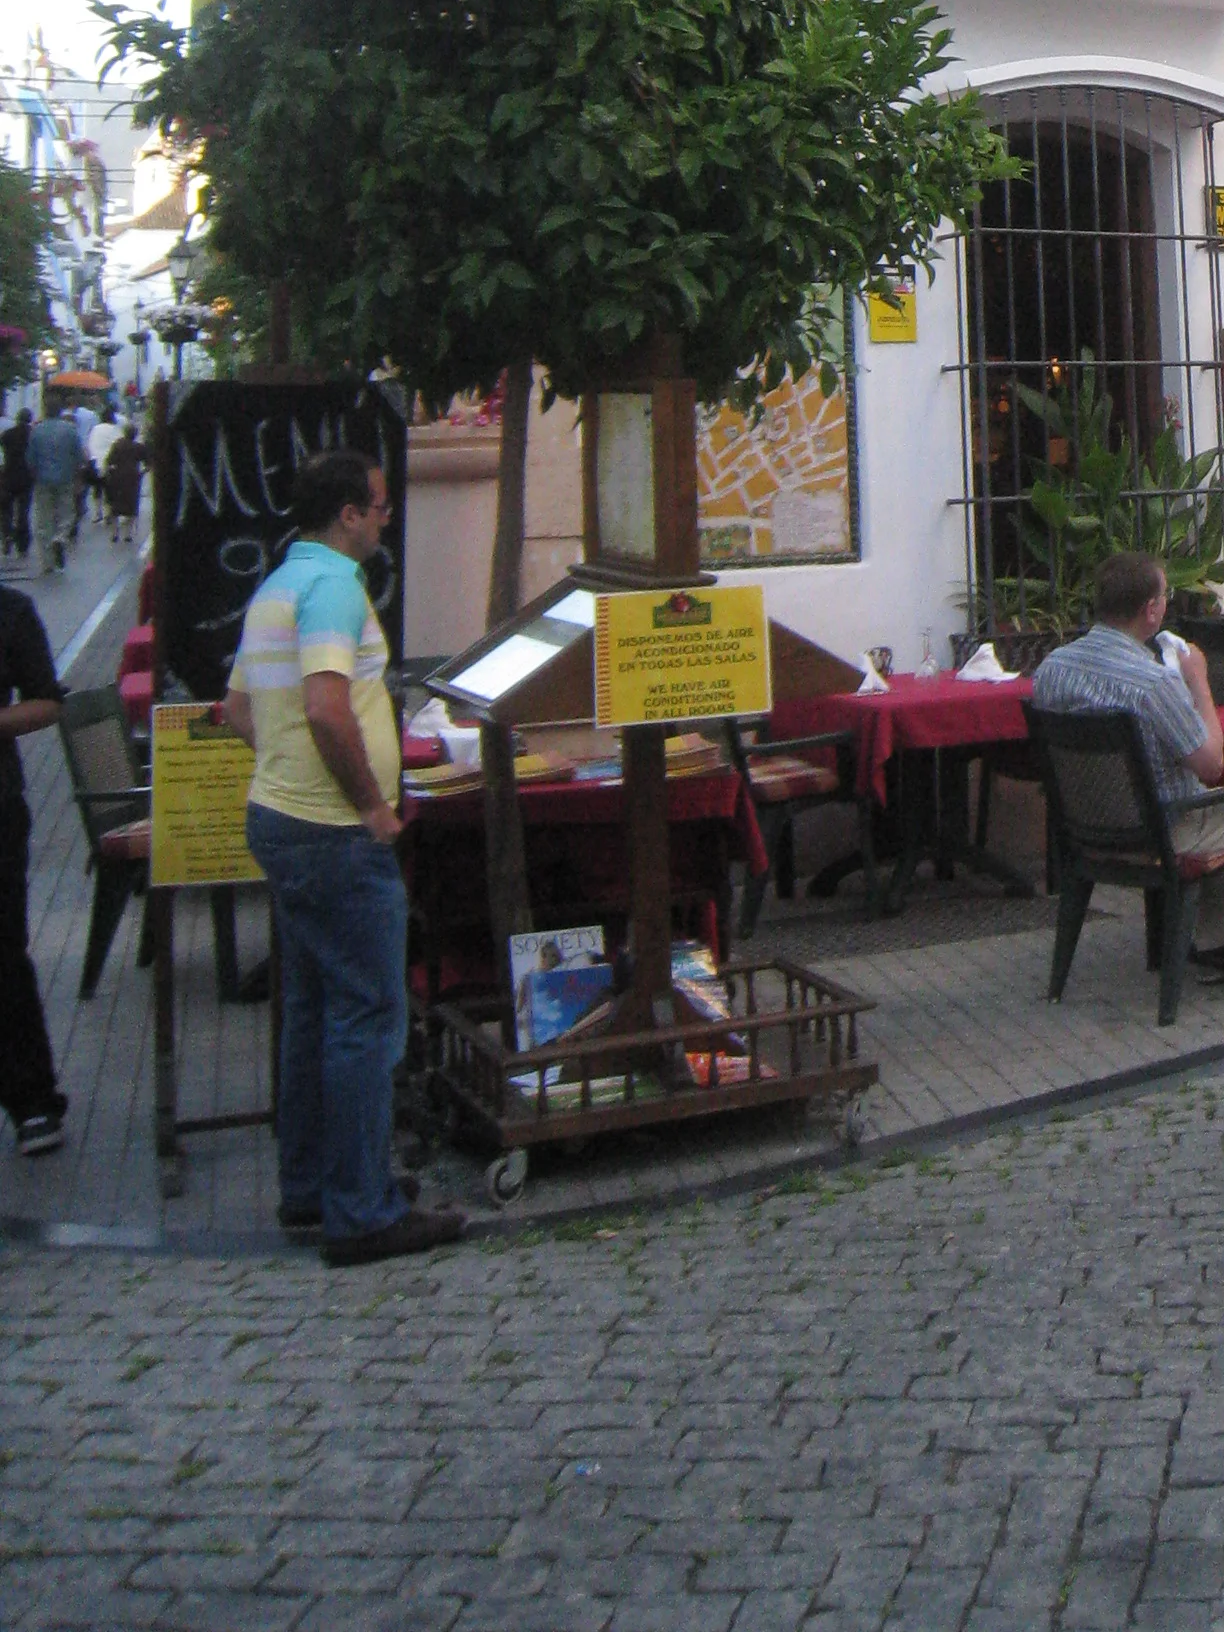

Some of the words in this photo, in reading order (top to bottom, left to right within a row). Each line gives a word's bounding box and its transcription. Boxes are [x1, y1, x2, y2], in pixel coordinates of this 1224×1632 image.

[617, 631, 702, 648] DISPONEMOS
[706, 630, 722, 640] DE
[727, 627, 755, 638] AIRE
[634, 641, 740, 659] ACONDICIONADO
[618, 662, 635, 673] EN
[641, 659, 683, 671] TODAS
[687, 655, 712, 667] LAS
[715, 652, 757, 664] SALAS
[648, 683, 667, 694] WE
[671, 680, 705, 693] HAVE
[709, 678, 731, 689] AIR
[643, 690, 736, 707] CONDITIONING
[645, 709, 658, 720] IN
[662, 707, 686, 718] ALL
[688, 701, 735, 717] ROOMS
[513, 928, 602, 955] SOETY
